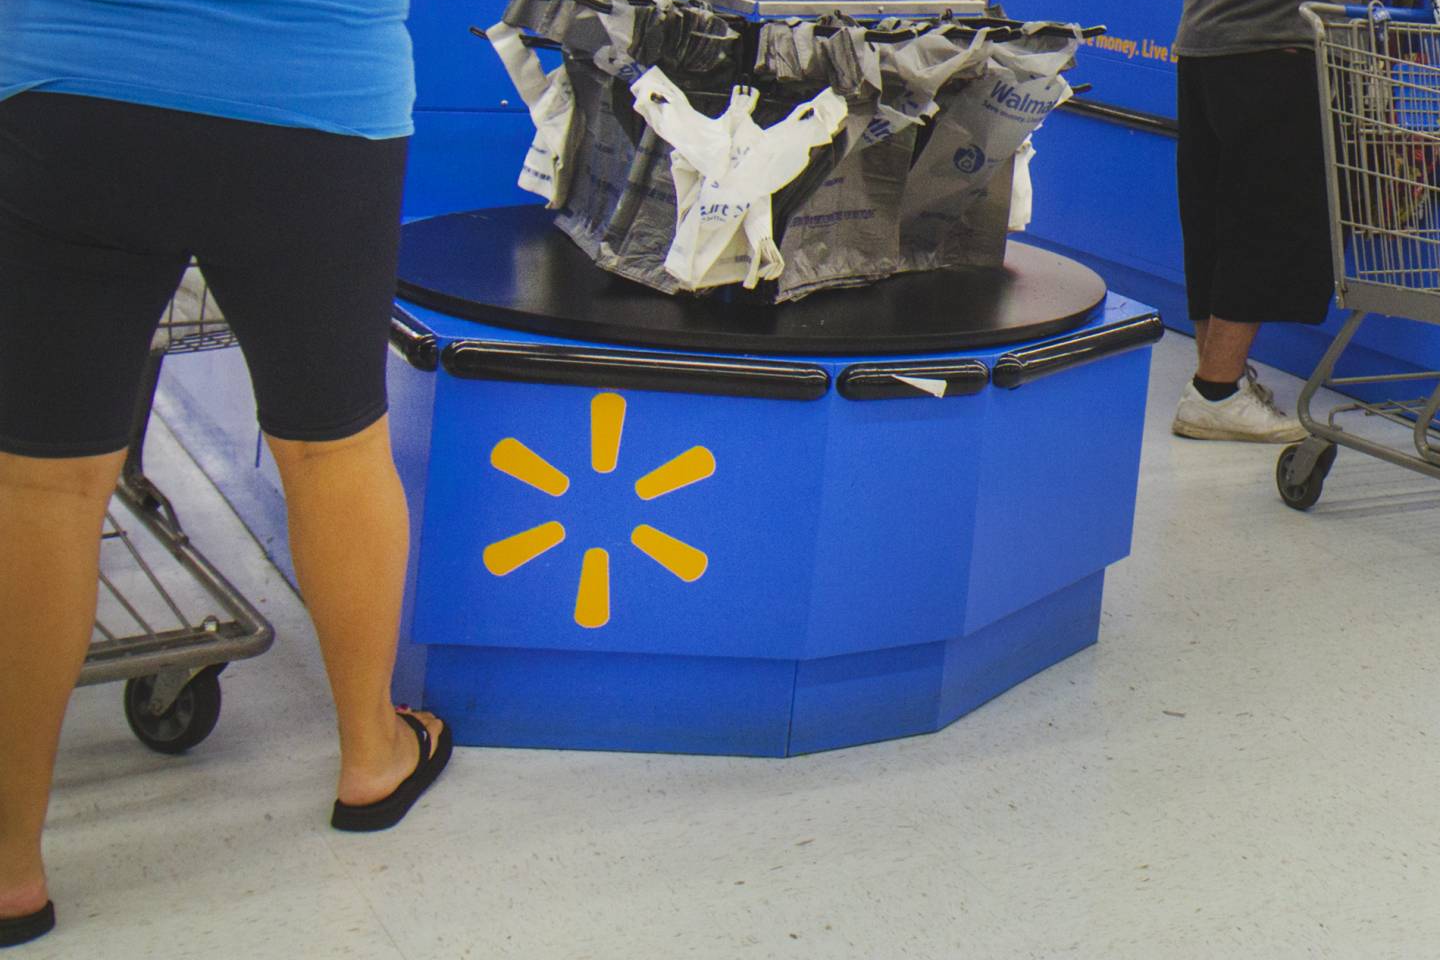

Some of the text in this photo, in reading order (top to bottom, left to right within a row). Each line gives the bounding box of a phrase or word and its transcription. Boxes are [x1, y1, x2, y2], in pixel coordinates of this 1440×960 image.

[1095, 34, 1139, 59] money.
[1141, 38, 1168, 61] Live
[990, 80, 1059, 115] Walma
